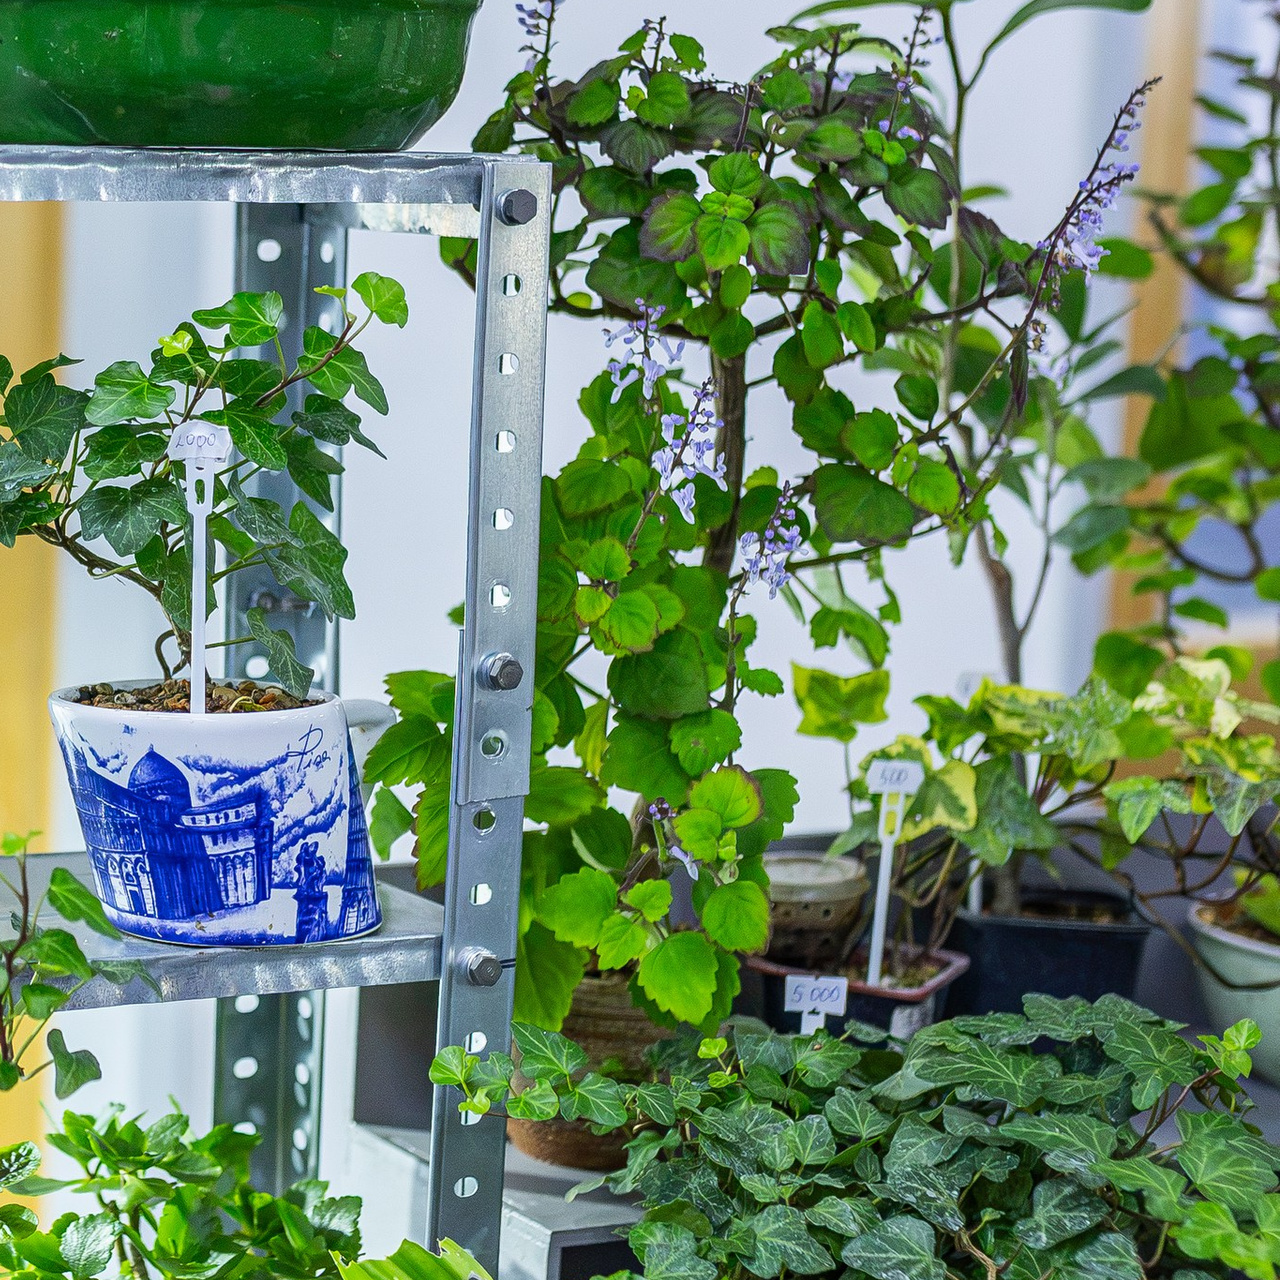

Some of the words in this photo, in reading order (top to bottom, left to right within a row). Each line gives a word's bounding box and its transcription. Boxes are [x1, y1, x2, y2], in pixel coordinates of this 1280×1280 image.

[175, 432, 216, 448] 2000
[792, 983, 806, 1004] 5
[810, 985, 840, 1003] 000
